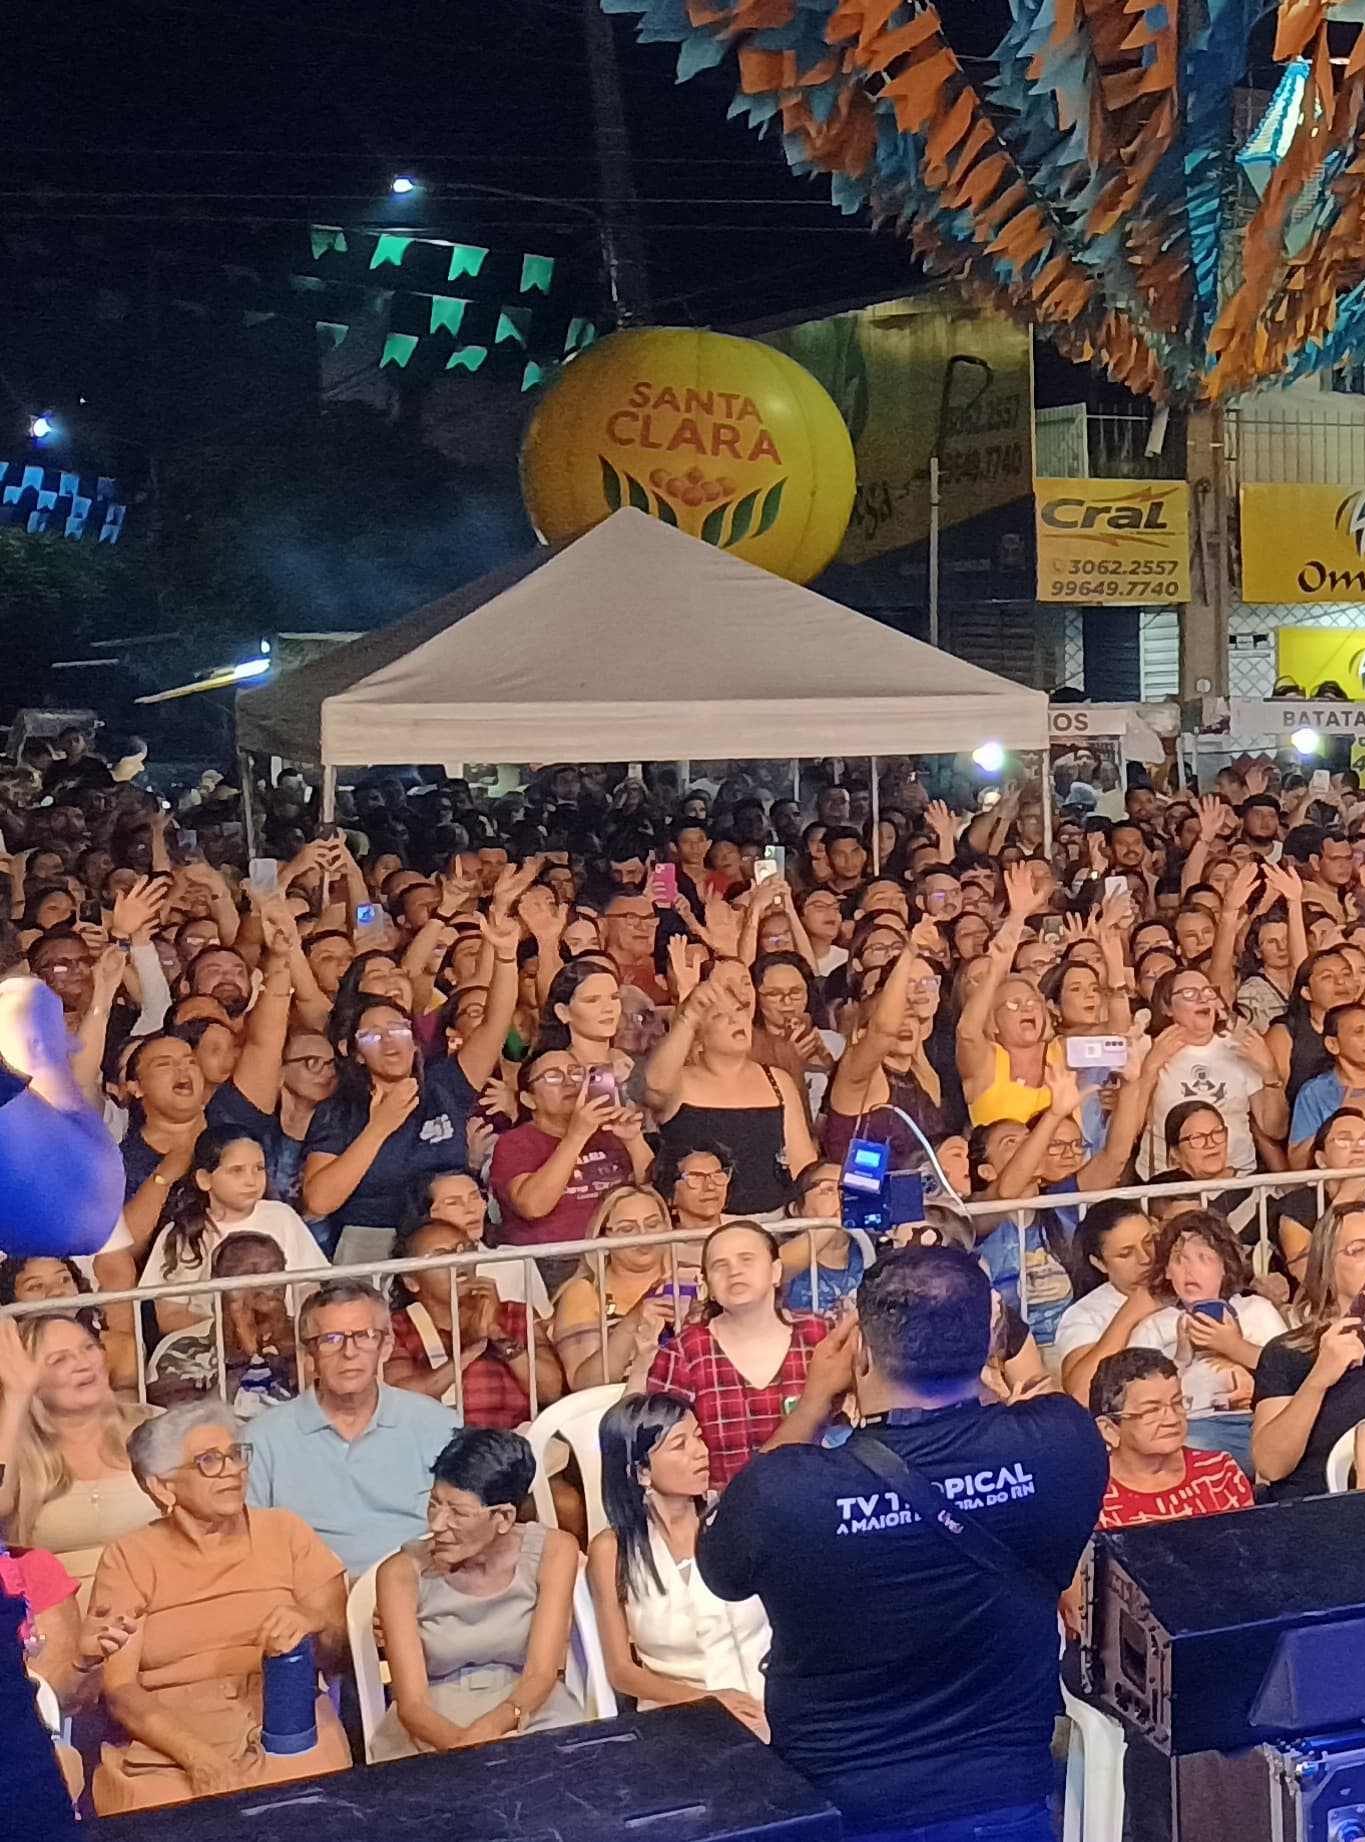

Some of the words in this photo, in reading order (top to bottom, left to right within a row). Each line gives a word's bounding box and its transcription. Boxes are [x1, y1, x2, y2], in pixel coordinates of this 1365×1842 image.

[629, 381, 764, 424] SANTA
[606, 410, 783, 466] CLARA
[1041, 498, 1168, 530] Cral
[1068, 559, 1179, 576] 3062.2557
[1051, 580, 1179, 597] 99649.7740
[836, 1493, 880, 1521] TV
[836, 1523, 849, 1536] A
[852, 1510, 912, 1534] MAIOR
[986, 1491, 1009, 1507] DO
[1010, 1481, 1036, 1499] RN
